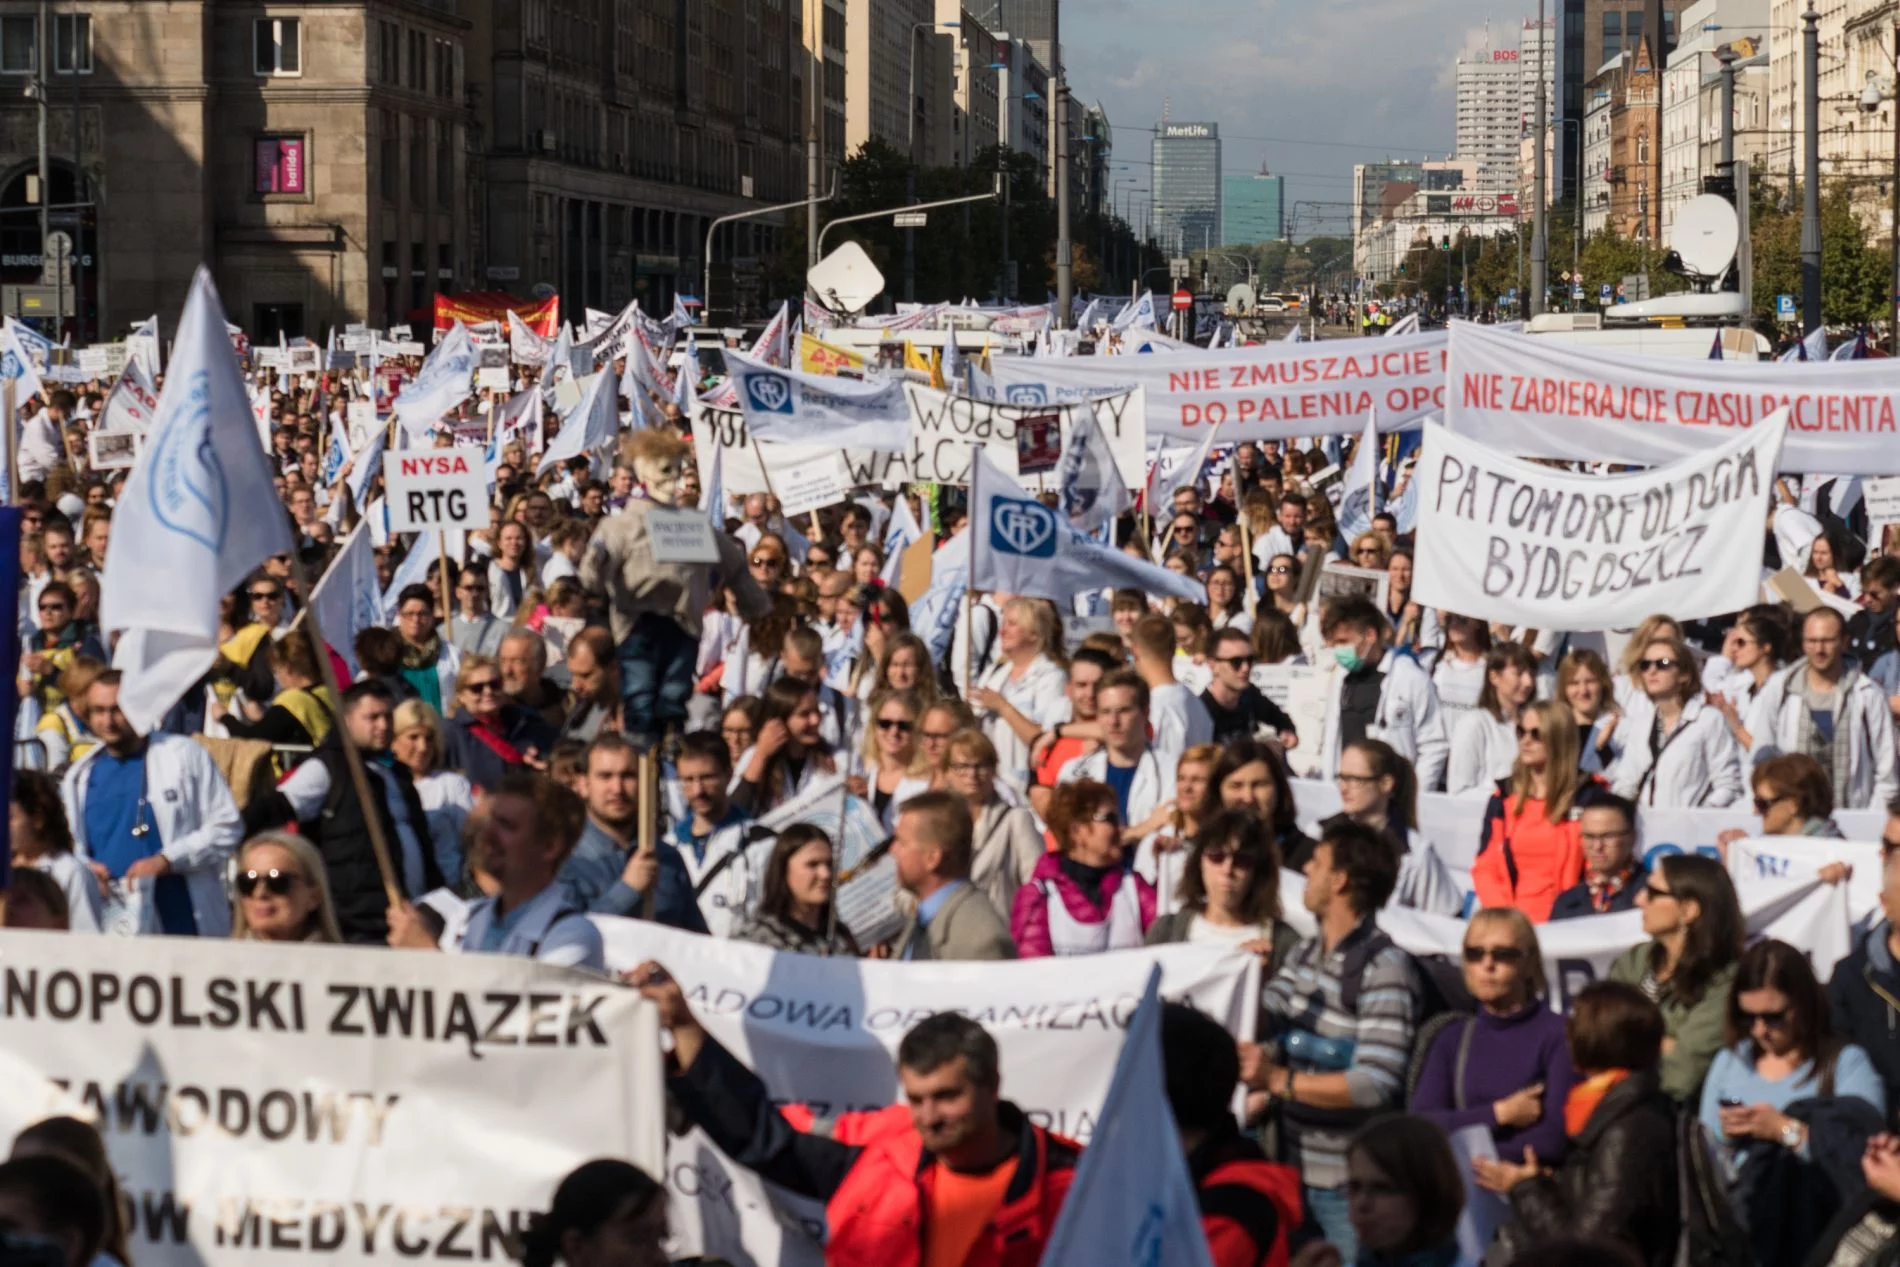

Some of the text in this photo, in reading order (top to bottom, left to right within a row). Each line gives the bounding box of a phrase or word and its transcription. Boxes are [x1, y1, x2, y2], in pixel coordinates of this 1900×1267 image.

[1167, 125, 1208, 137] MetLife
[1168, 368, 1221, 393] NIE
[1230, 350, 1431, 388] ZMUSZAJCIE
[1181, 401, 1228, 427] DO
[1237, 389, 1374, 424] PALENIA
[1463, 372, 1503, 410] NIE
[1510, 375, 1668, 423] ZABIERAJCIE
[1675, 389, 1753, 428] CZASU
[401, 456, 469, 476] NYSA
[407, 488, 468, 523] RTG
[1482, 525, 1709, 600] BYDGOSZCZ
[4, 967, 609, 1060] NOPOLSKI ZWIĄZEK
